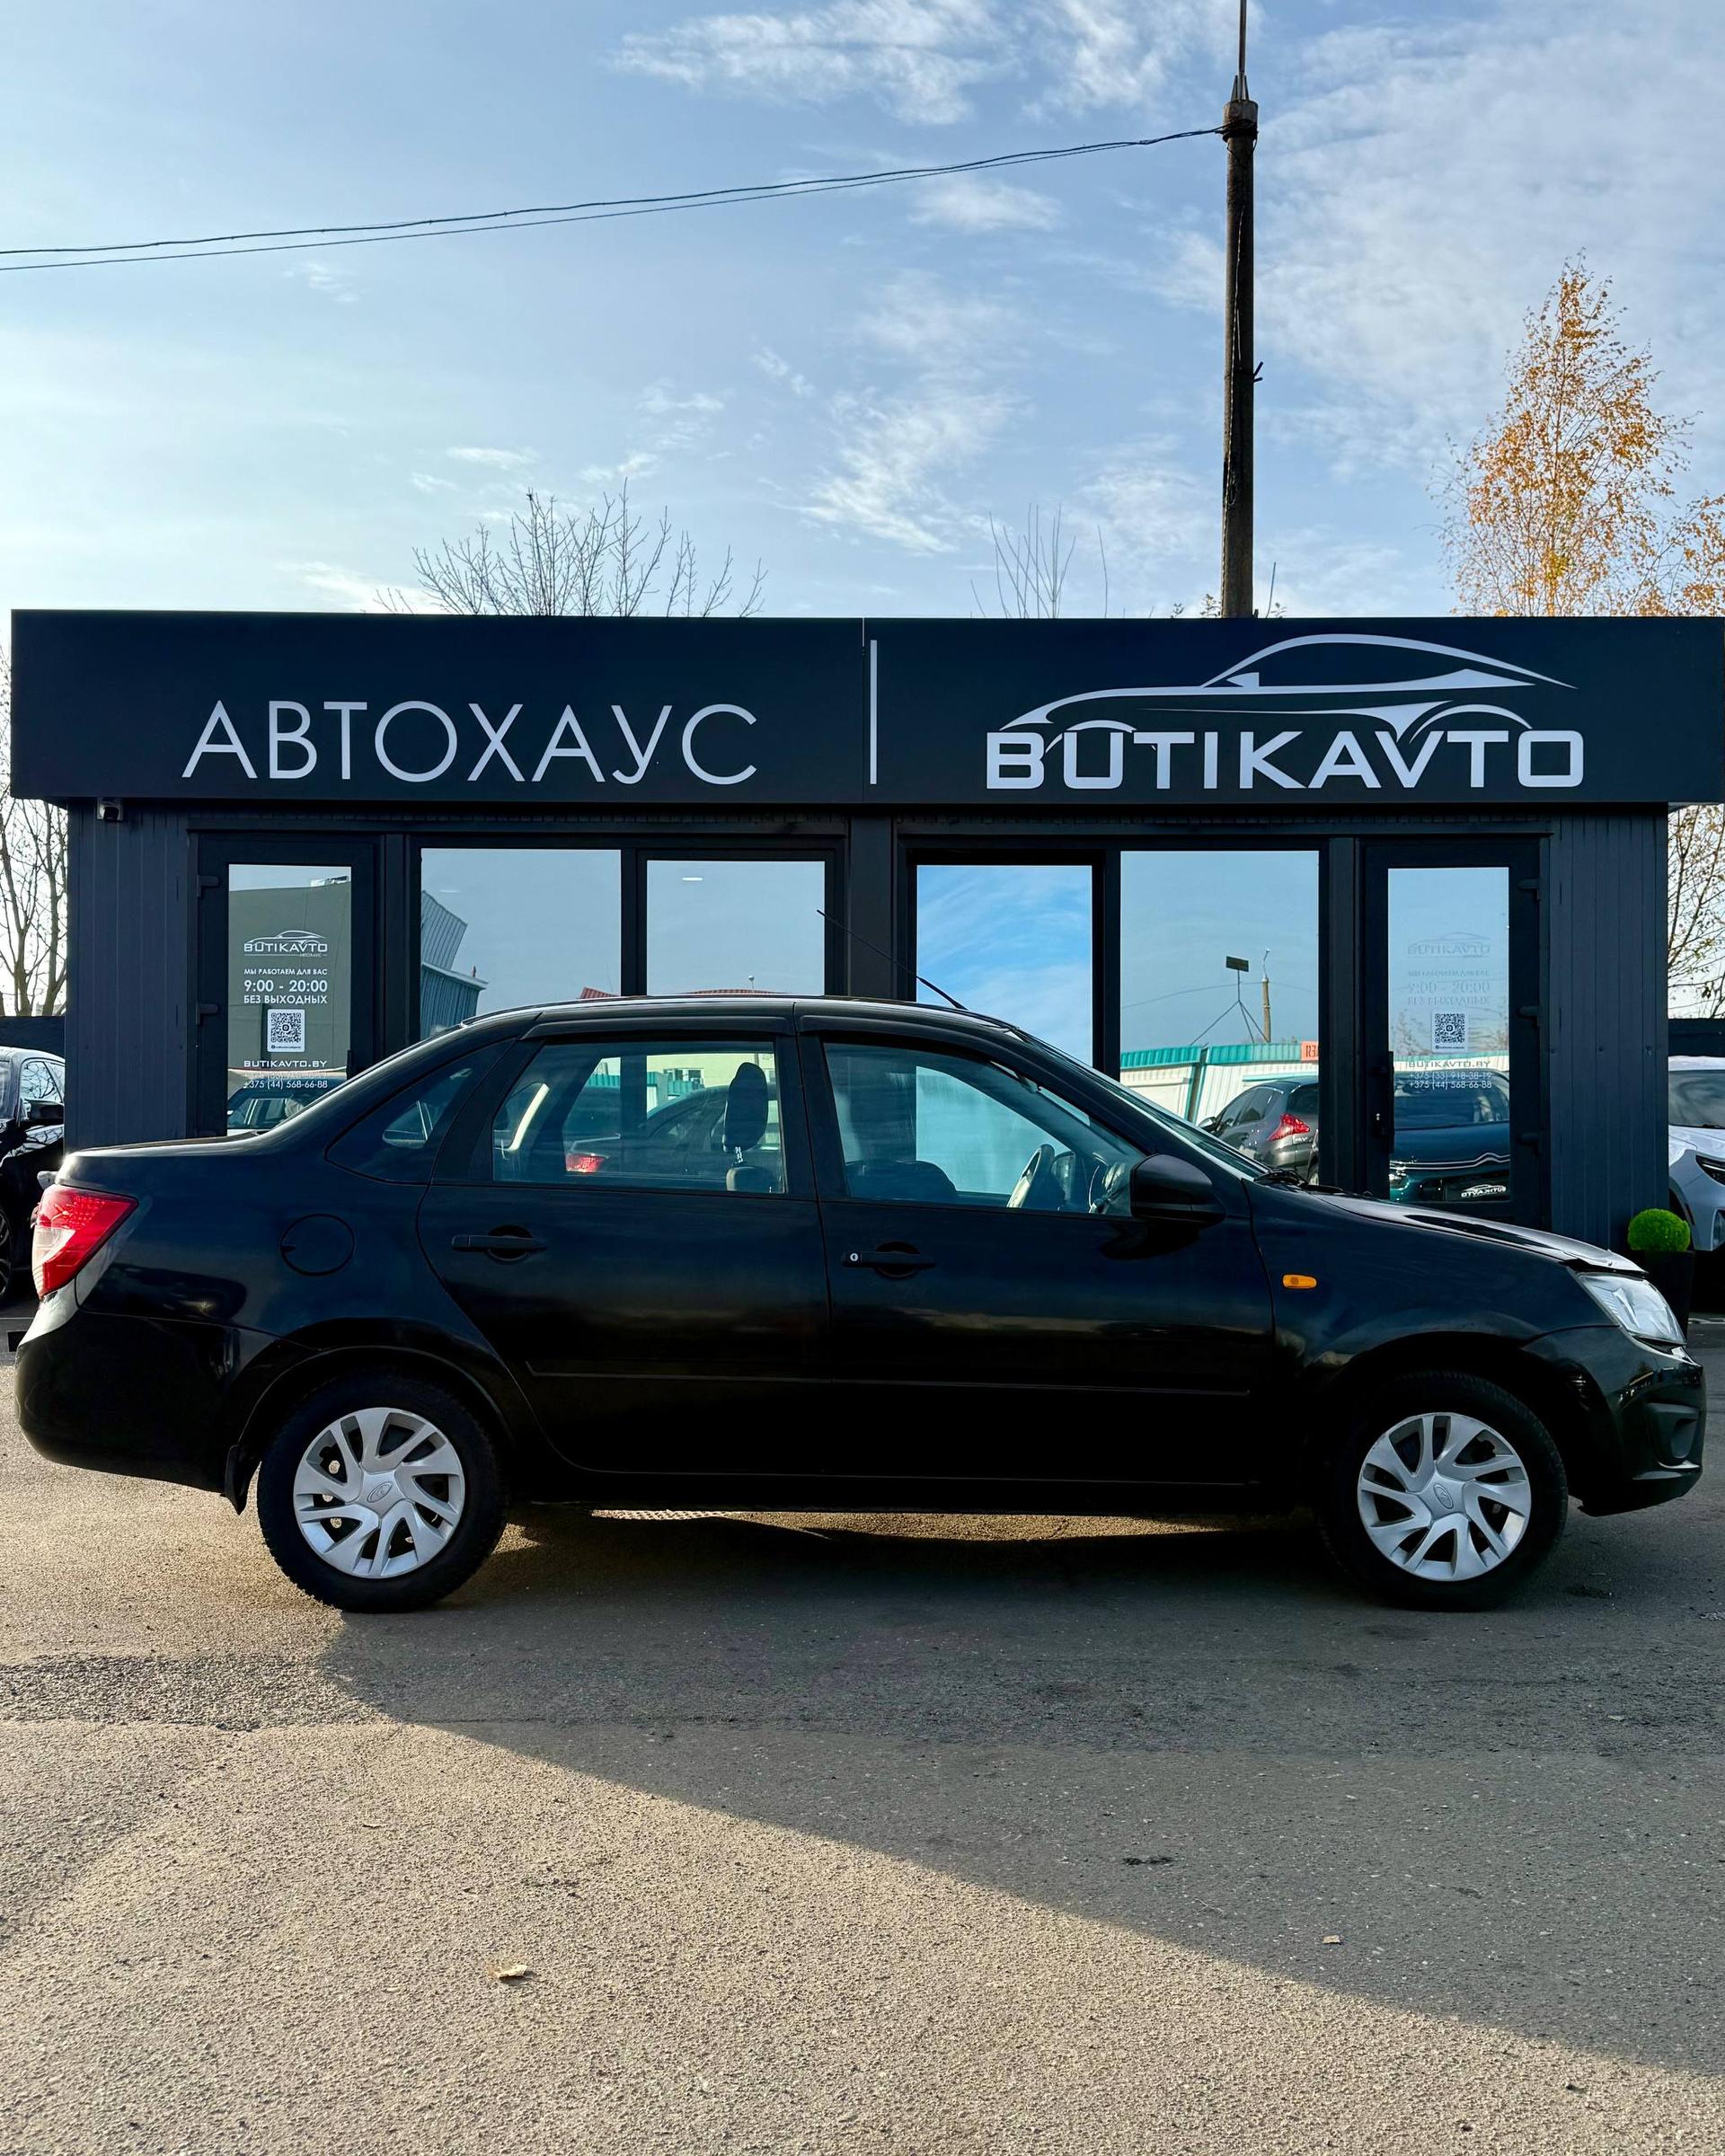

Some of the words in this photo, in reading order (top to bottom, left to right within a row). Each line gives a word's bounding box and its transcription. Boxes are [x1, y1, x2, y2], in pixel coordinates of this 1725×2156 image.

[181, 700, 757, 785] АВТОХАУС
[986, 729, 1584, 790] BUTIKAVTO
[243, 942, 328, 952] BUTIKAVTO
[243, 979, 274, 993] 9:00
[288, 979, 328, 993] 20:00
[243, 994, 261, 1004] БЕЗ
[264, 994, 328, 1005] ВЫХОДНЫХ
[243, 1060, 328, 1068] BUTIKAVTO.BY
[1408, 1060, 1491, 1069] BUTIKAVTO.BY
[267, 1080, 284, 1090] (44)
[286, 1080, 329, 1089] 568-66-88
[1409, 1081, 1430, 1089] +375
[1432, 1080, 1448, 1091] (44)
[1450, 1081, 1492, 1089] 568-66-88
